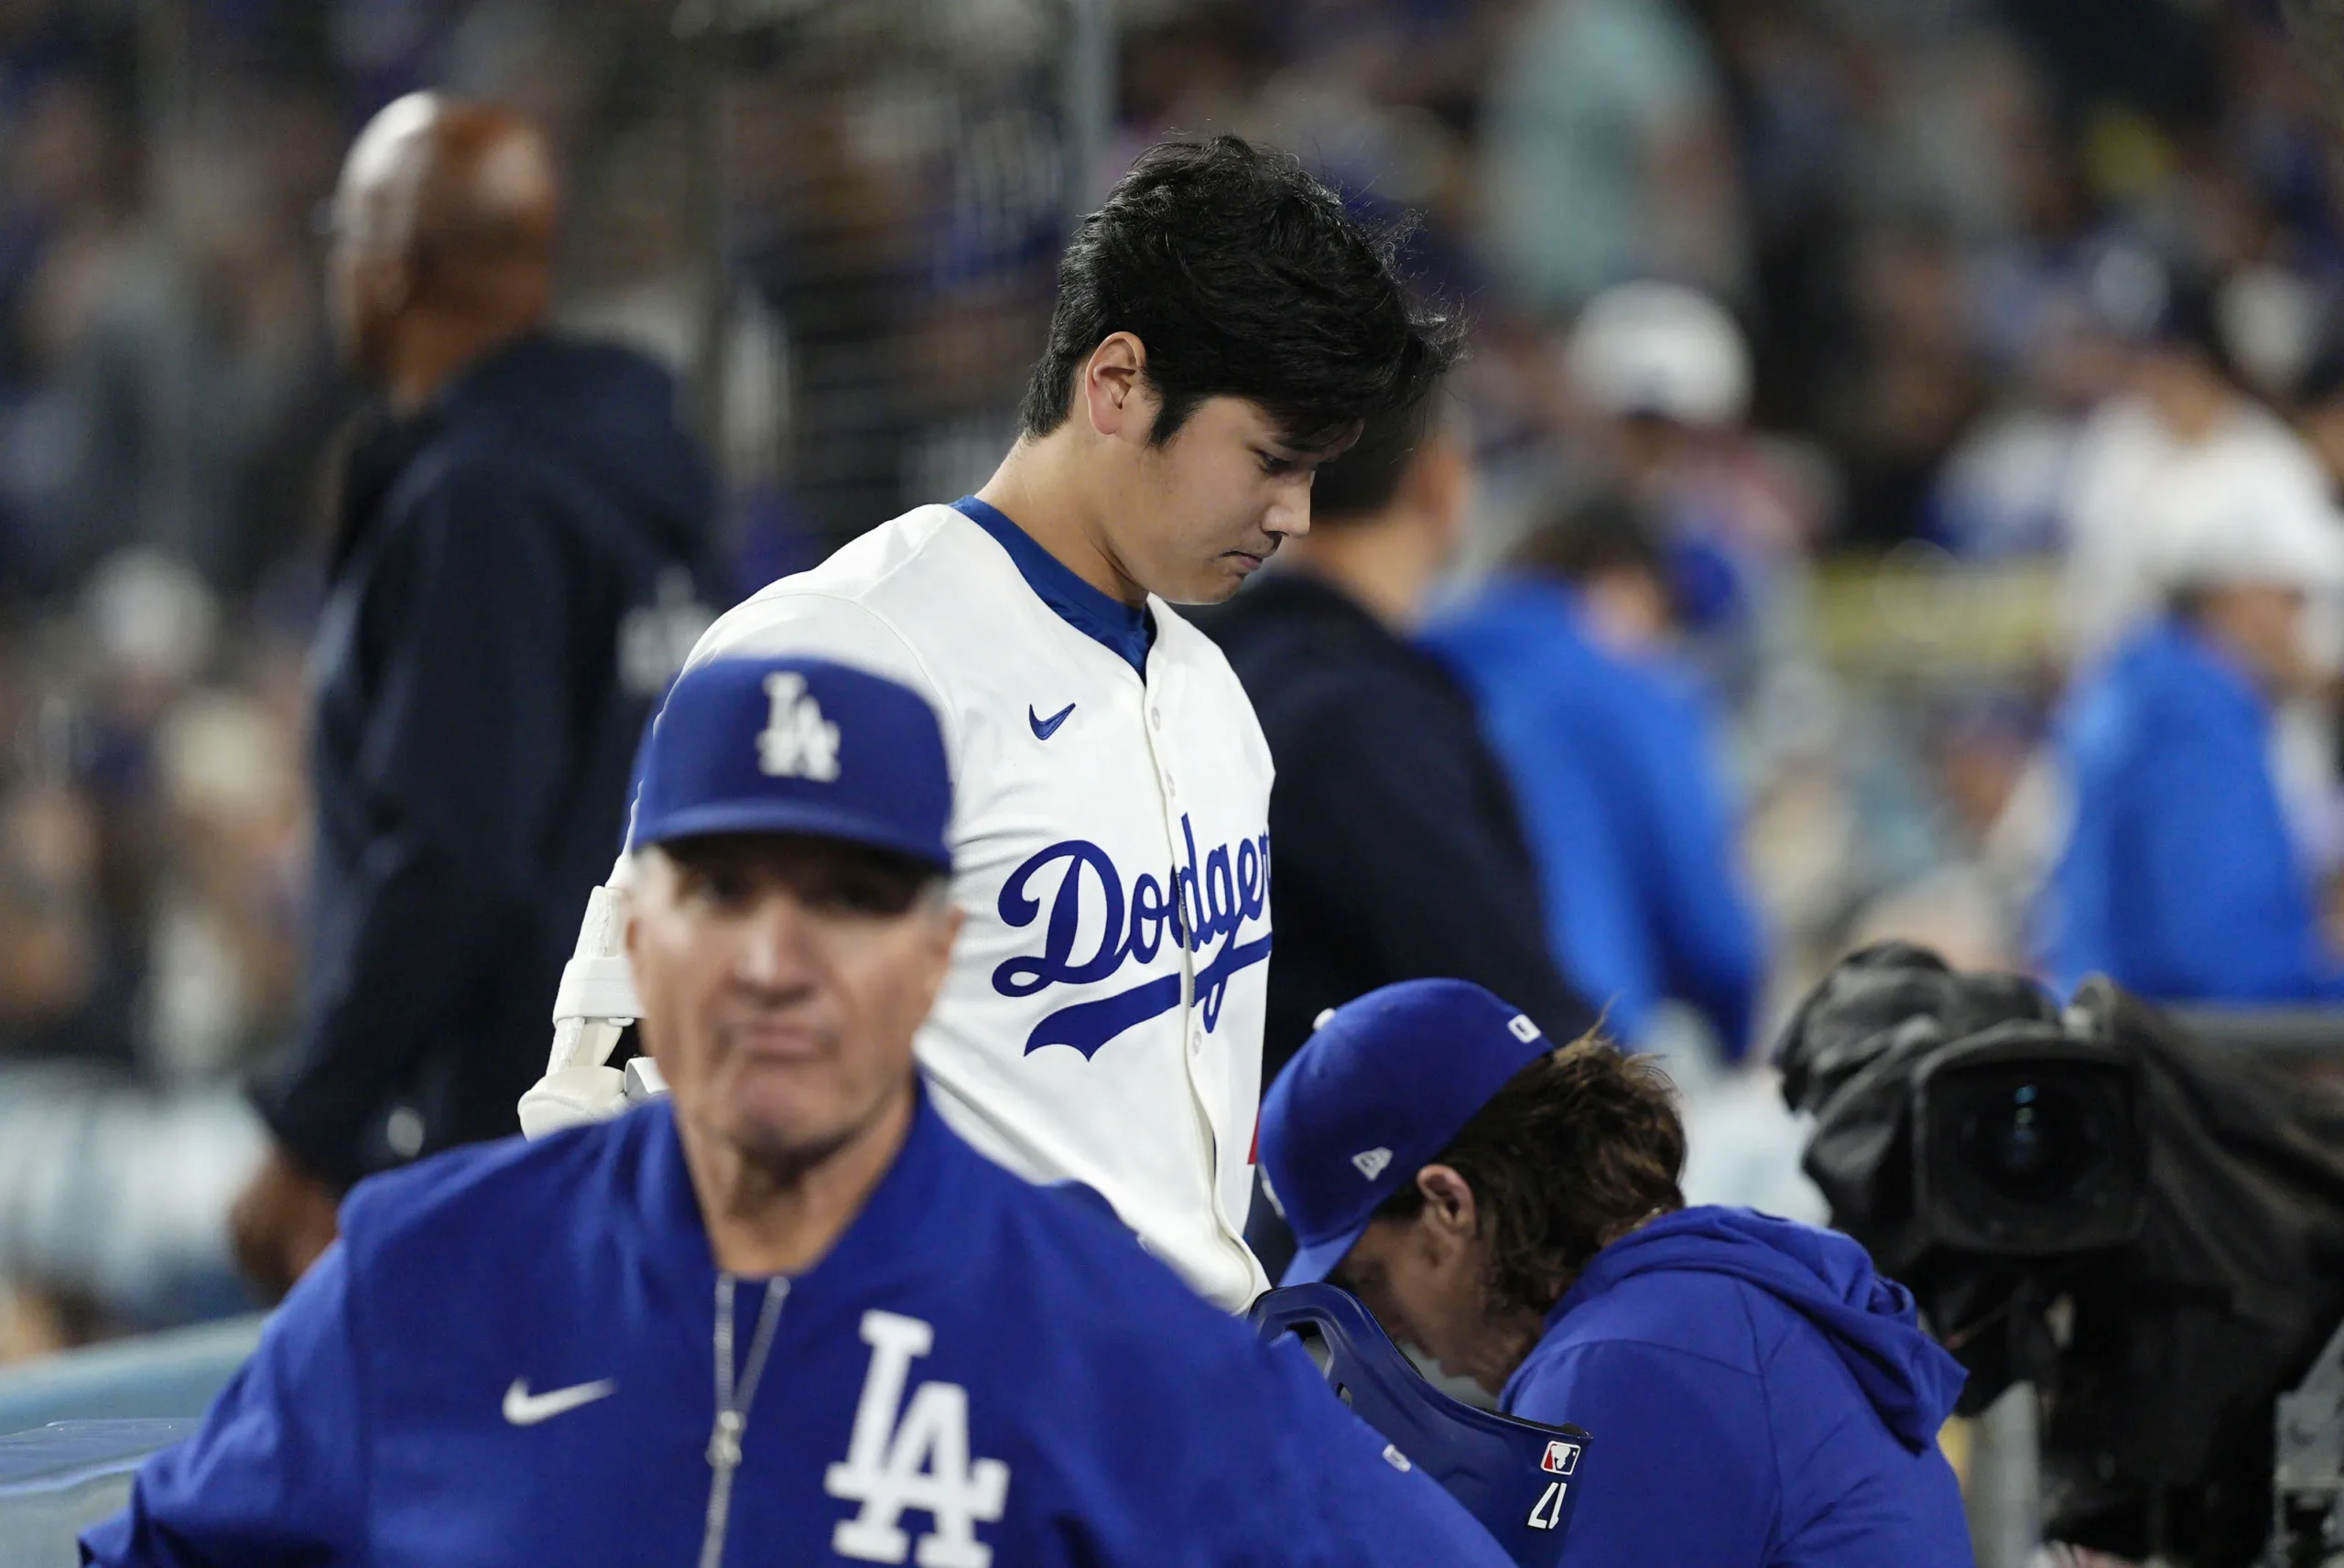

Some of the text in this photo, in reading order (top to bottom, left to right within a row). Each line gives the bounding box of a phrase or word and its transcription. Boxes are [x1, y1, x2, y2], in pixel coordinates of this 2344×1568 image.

[755, 671, 841, 783] LA
[823, 1308, 1012, 1568] LA
[1527, 1482, 1568, 1530] 17
